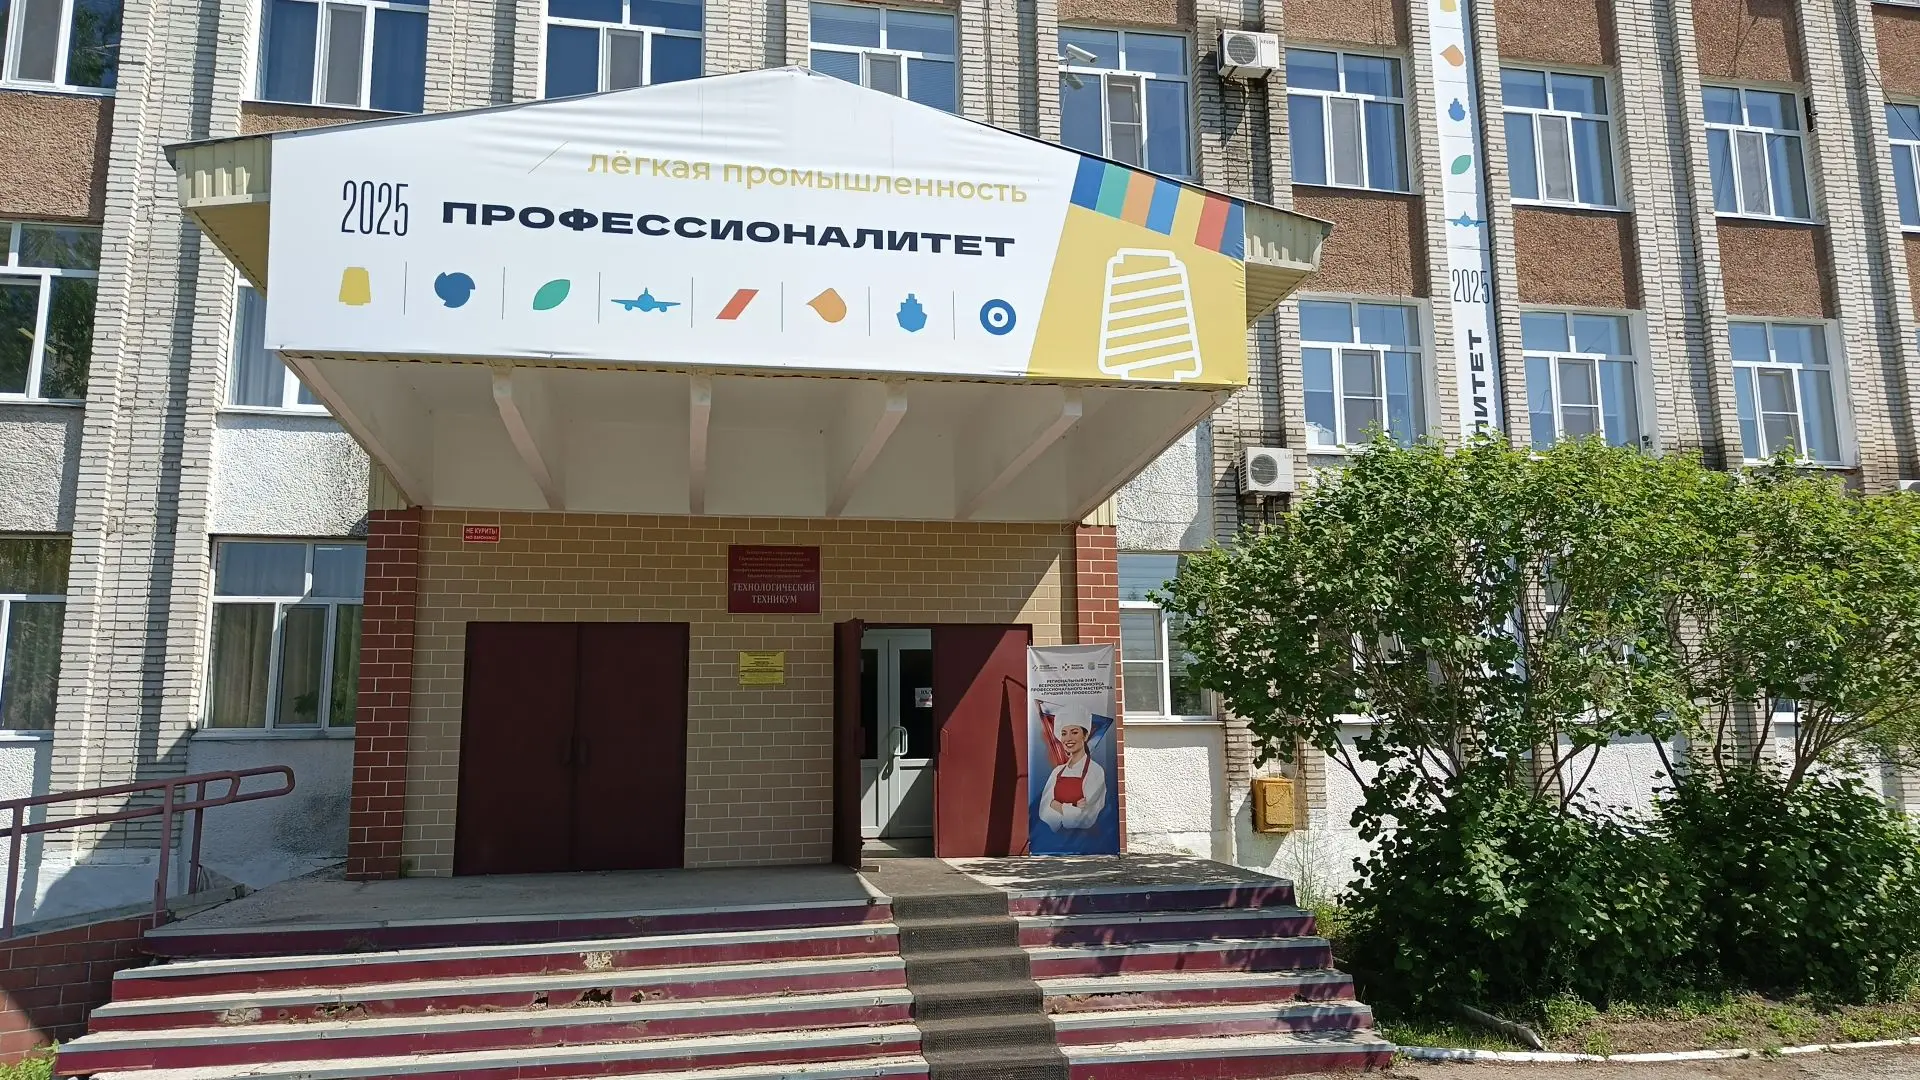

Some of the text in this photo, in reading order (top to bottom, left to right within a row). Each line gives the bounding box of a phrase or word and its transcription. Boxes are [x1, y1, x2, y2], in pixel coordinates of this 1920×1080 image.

[588, 150, 1028, 203] лёгкая промышленность
[341, 180, 409, 237] 2025
[442, 201, 1016, 258] ПРОФЕССИОНАЛИТЕТ
[1452, 268, 1490, 304] 2025
[732, 581, 815, 592] ТЕХНОЛОГИЧЕСКИЙ
[752, 594, 797, 604] ТЕХНИКУМ
